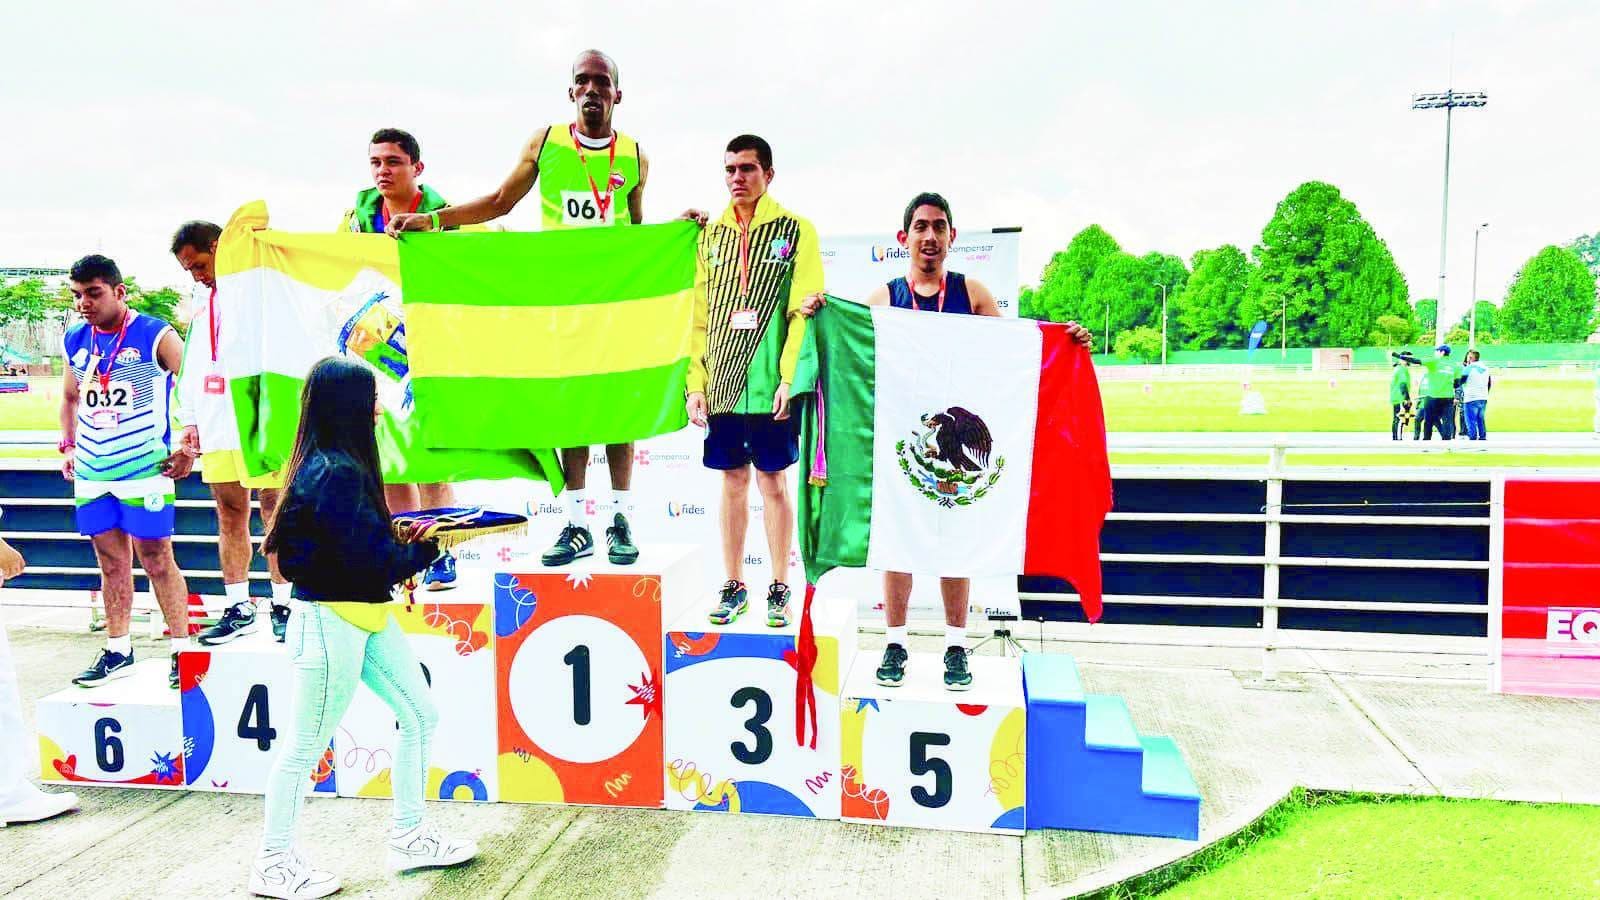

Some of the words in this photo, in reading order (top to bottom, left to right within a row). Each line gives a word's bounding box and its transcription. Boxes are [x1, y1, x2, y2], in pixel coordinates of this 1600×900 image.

[567, 198, 606, 219] 06
[539, 503, 563, 514] fides
[681, 504, 705, 515] fides
[459, 549, 480, 560] fides
[564, 644, 591, 726] 1
[94, 717, 125, 773] 6
[237, 684, 277, 752] 4
[730, 686, 773, 765] 3
[909, 731, 953, 809] 5
